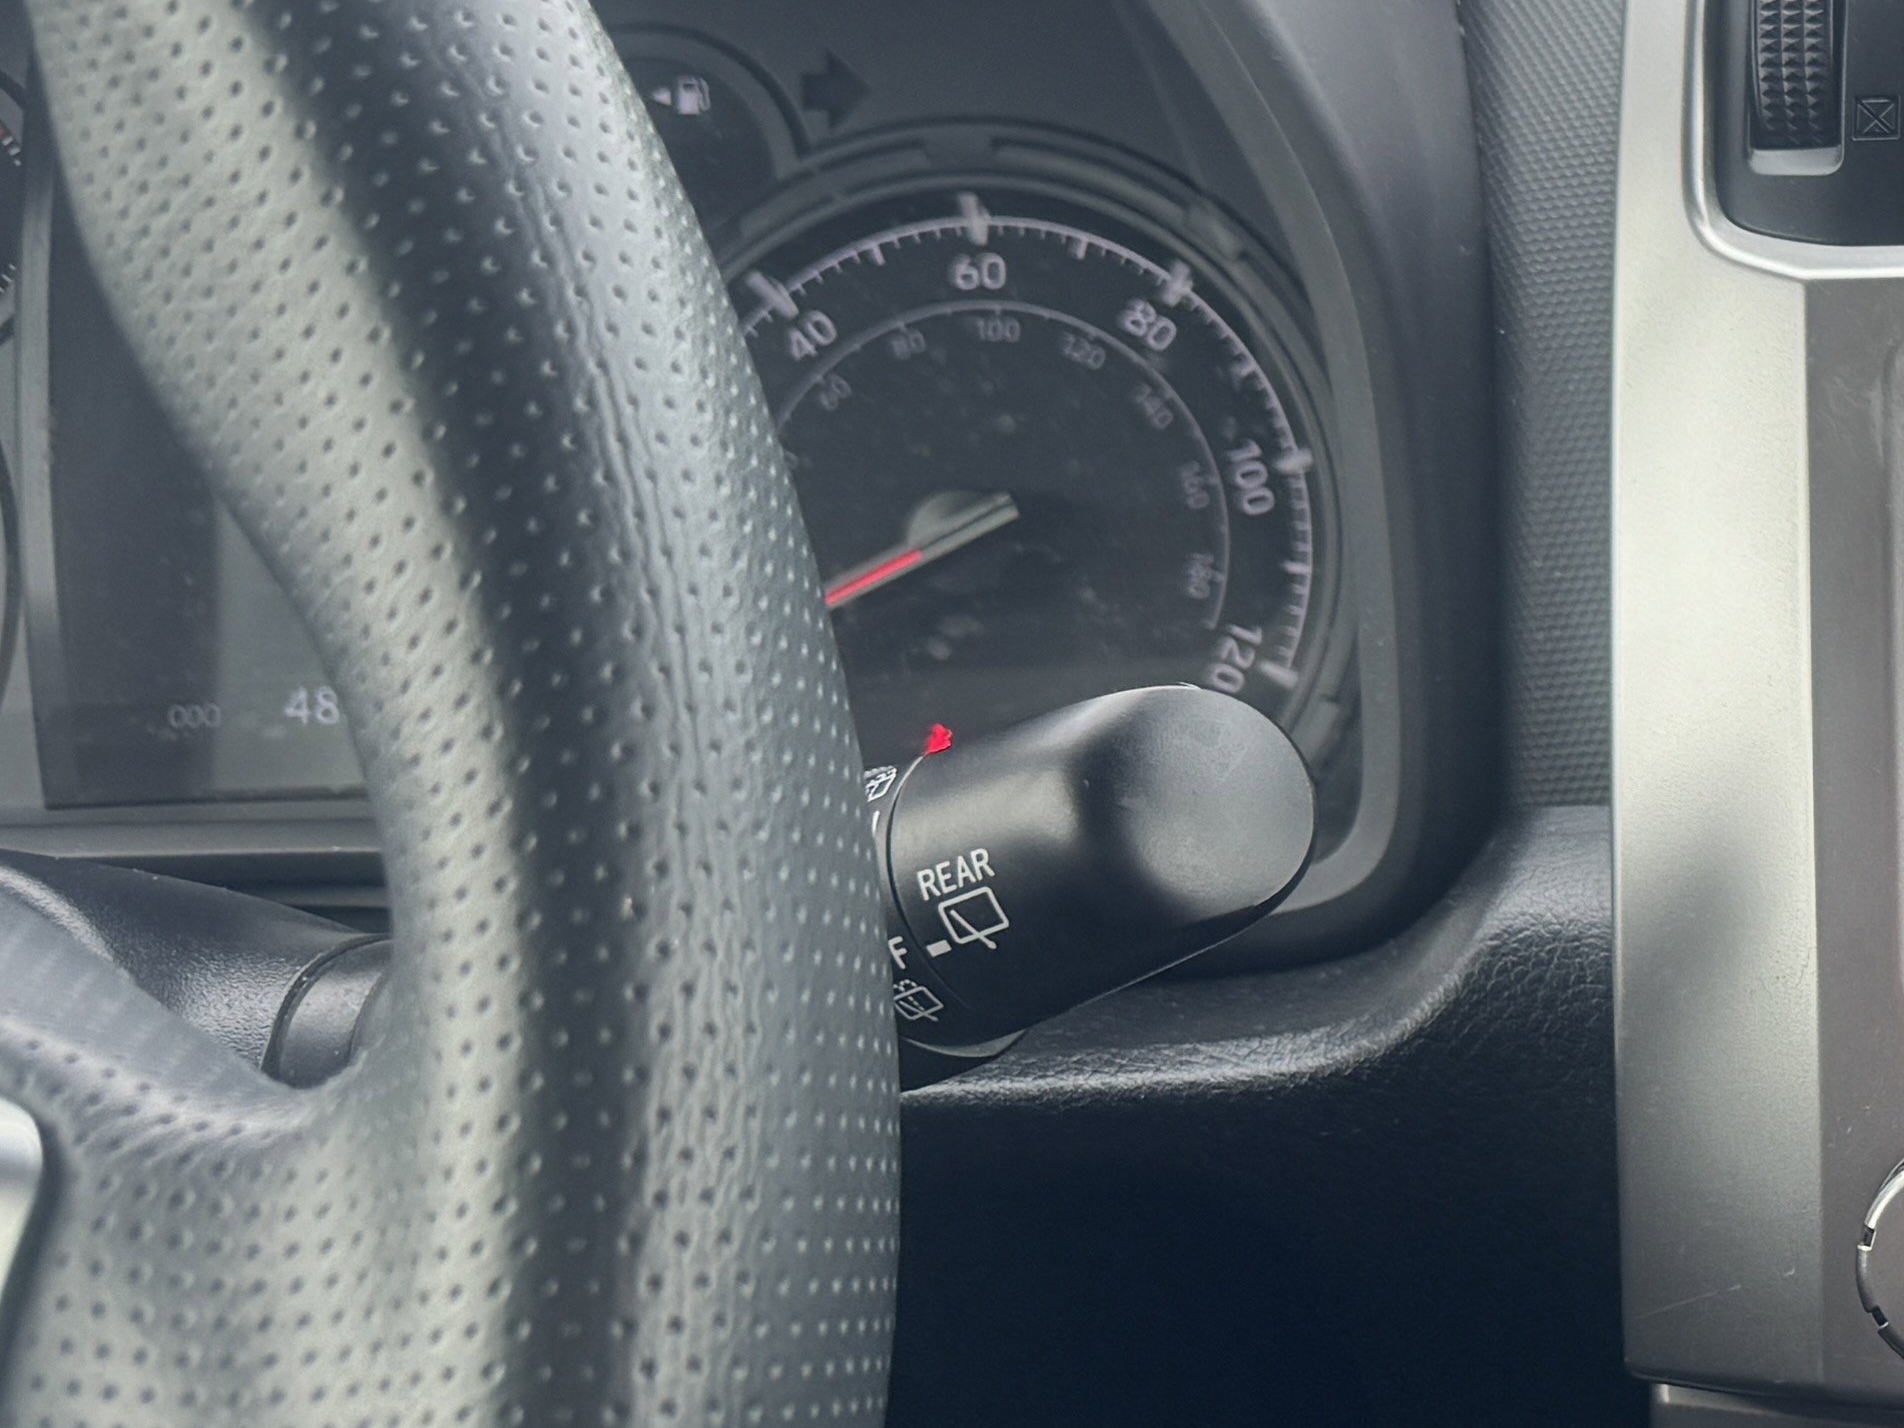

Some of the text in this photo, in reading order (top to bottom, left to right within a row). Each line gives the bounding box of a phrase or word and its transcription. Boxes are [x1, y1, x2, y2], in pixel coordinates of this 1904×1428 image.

[950, 252, 1007, 290] 60
[789, 310, 837, 360] 40
[1120, 299, 1177, 351] 80
[1227, 439, 1276, 515] 100
[1207, 622, 1263, 694] 120
[916, 847, 996, 901] REAR
